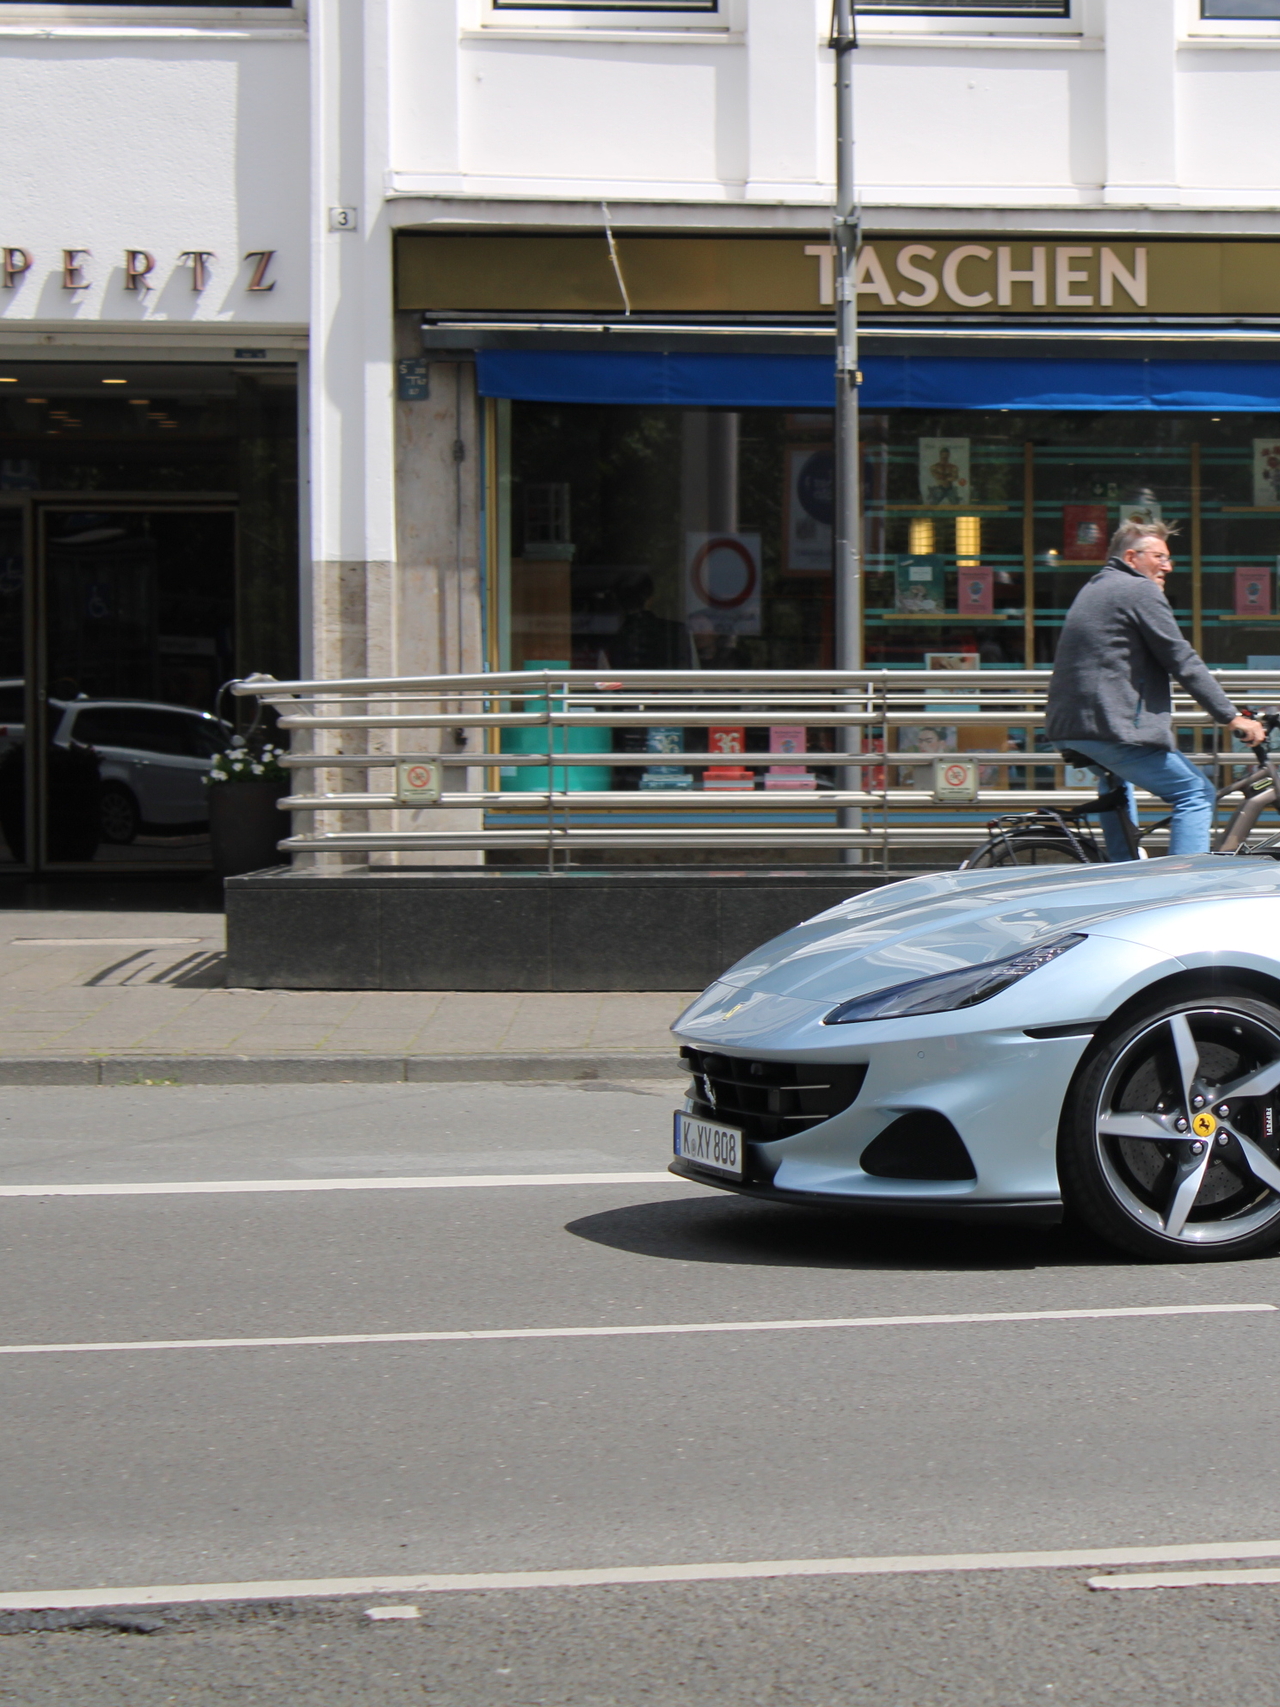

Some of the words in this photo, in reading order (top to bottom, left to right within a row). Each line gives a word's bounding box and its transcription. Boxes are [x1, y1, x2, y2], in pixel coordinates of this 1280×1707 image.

[338, 211, 348, 226] 3
[1, 247, 277, 292] PERTZ
[804, 244, 1147, 307] TASCHEN
[697, 1124, 712, 1160] XY
[713, 1130, 736, 1167] 808
